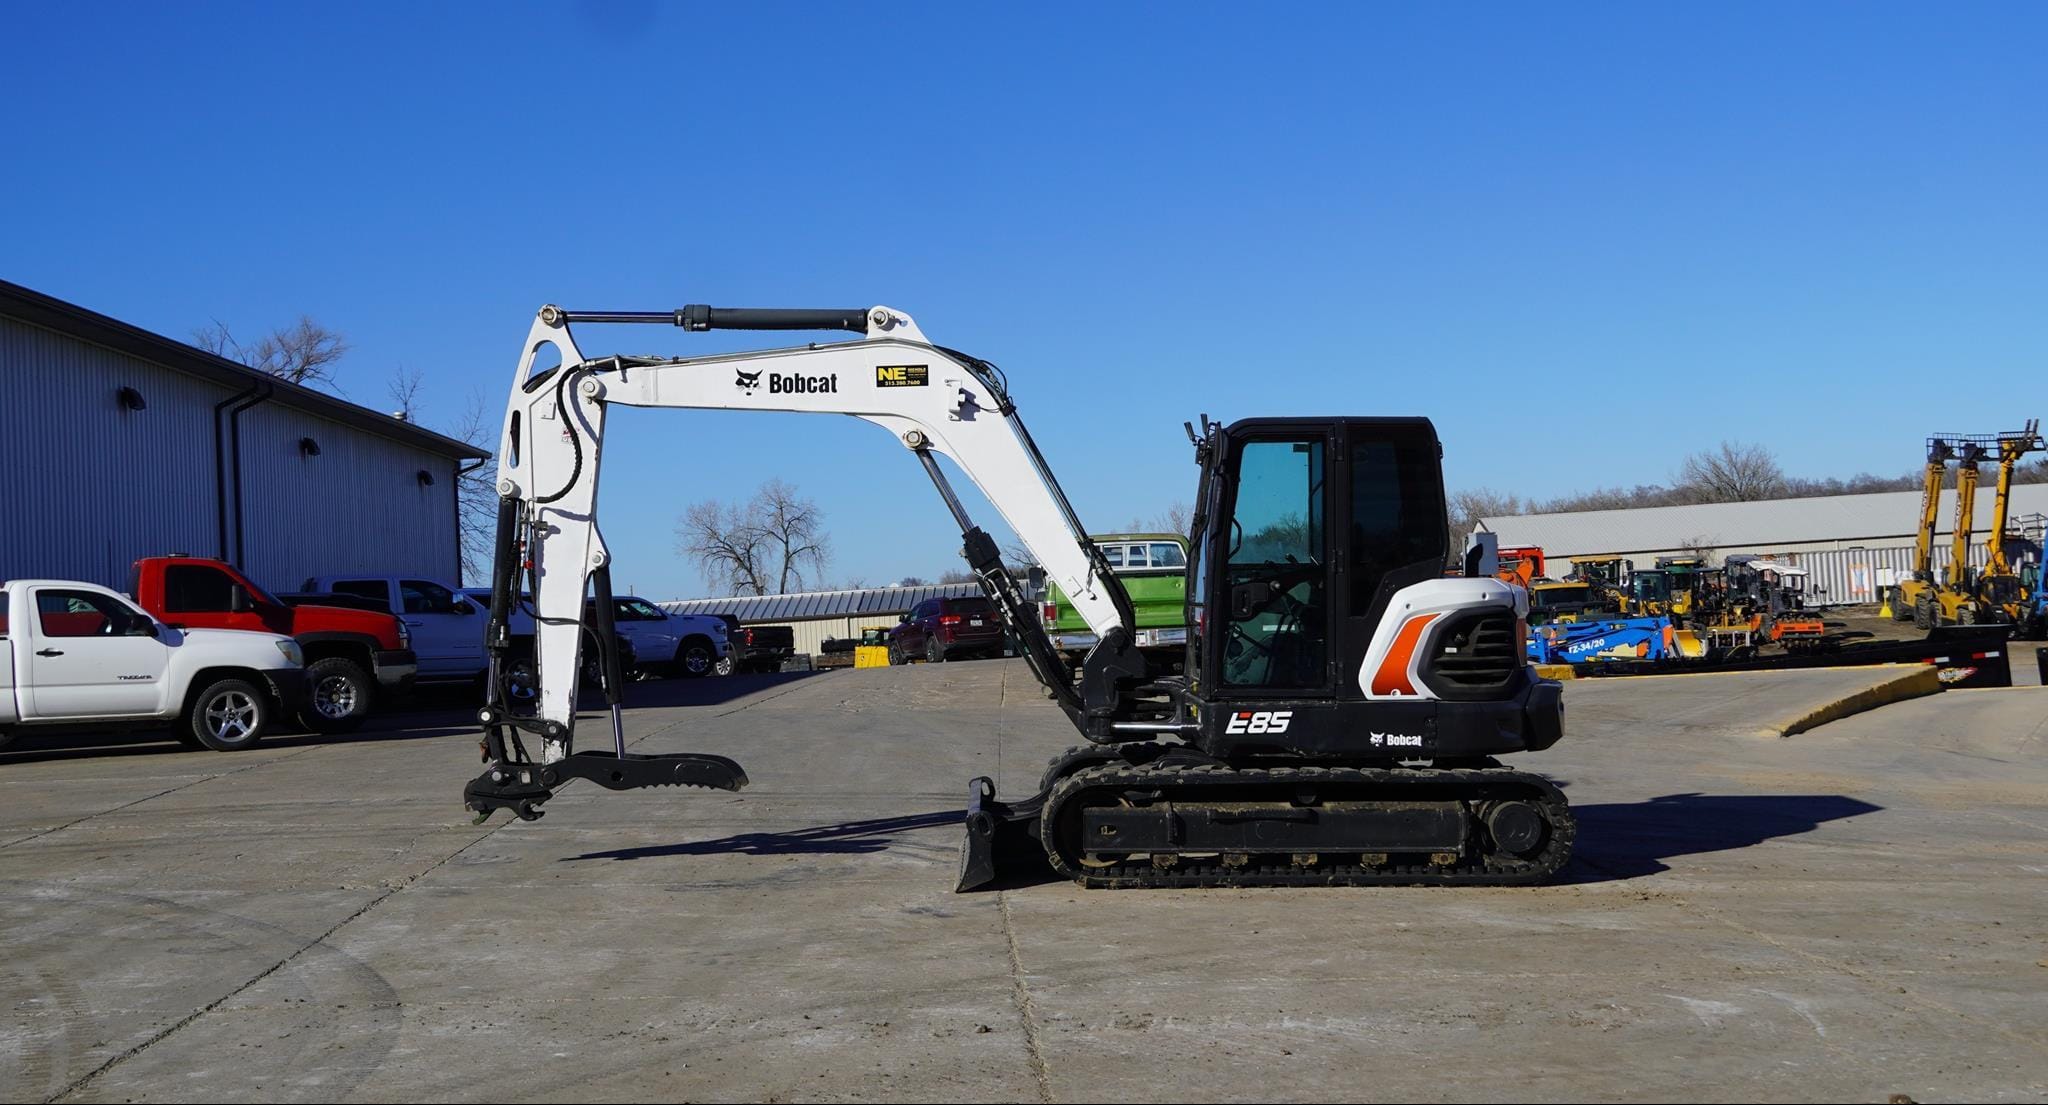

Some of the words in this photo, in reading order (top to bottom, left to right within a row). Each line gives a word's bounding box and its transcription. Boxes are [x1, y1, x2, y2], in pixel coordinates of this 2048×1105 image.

[878, 367, 907, 381] NE
[769, 373, 838, 394] Bobcat
[1225, 711, 1293, 734] E85
[1387, 734, 1422, 746] Bobcat
